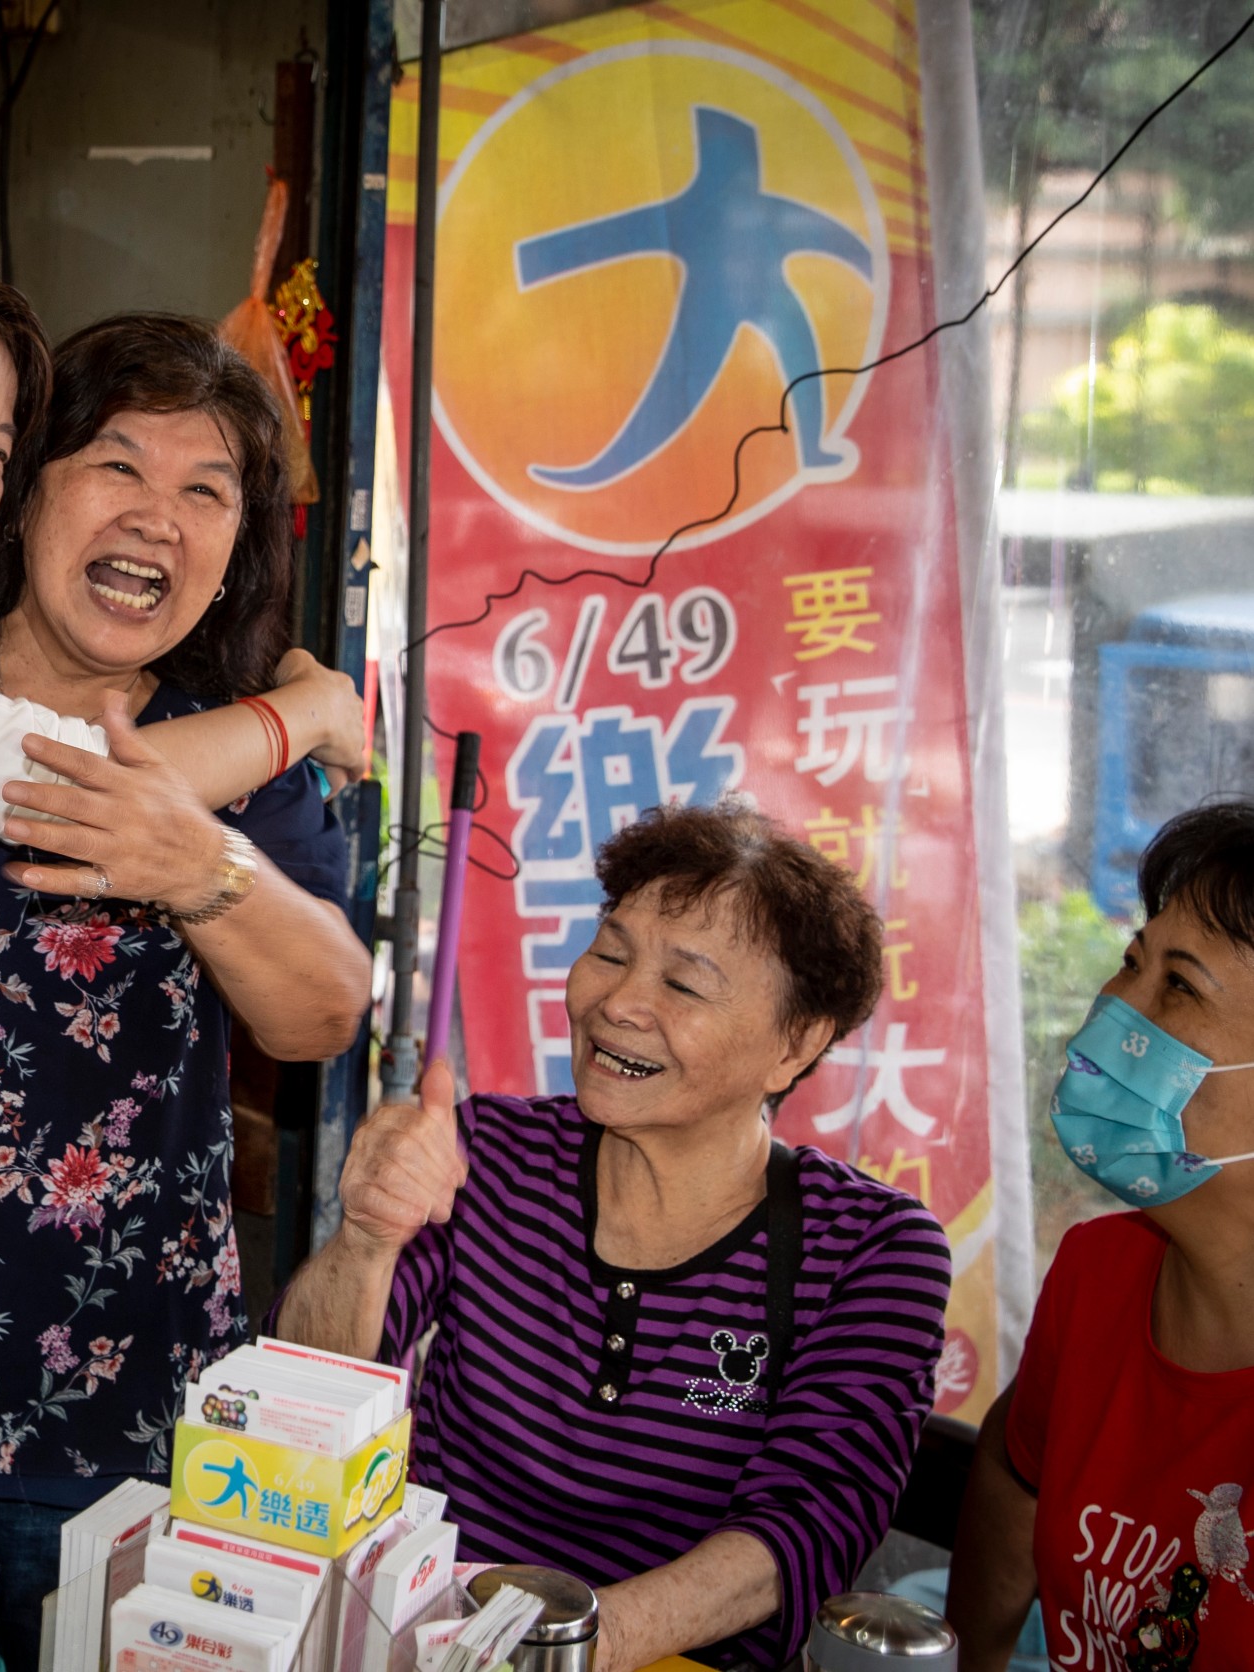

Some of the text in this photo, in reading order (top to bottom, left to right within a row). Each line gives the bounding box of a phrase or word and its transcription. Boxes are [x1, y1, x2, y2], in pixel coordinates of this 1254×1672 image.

[492, 586, 738, 710] 6/49
[1121, 1031, 1151, 1058] 33
[1073, 1504, 1181, 1590] STOP
